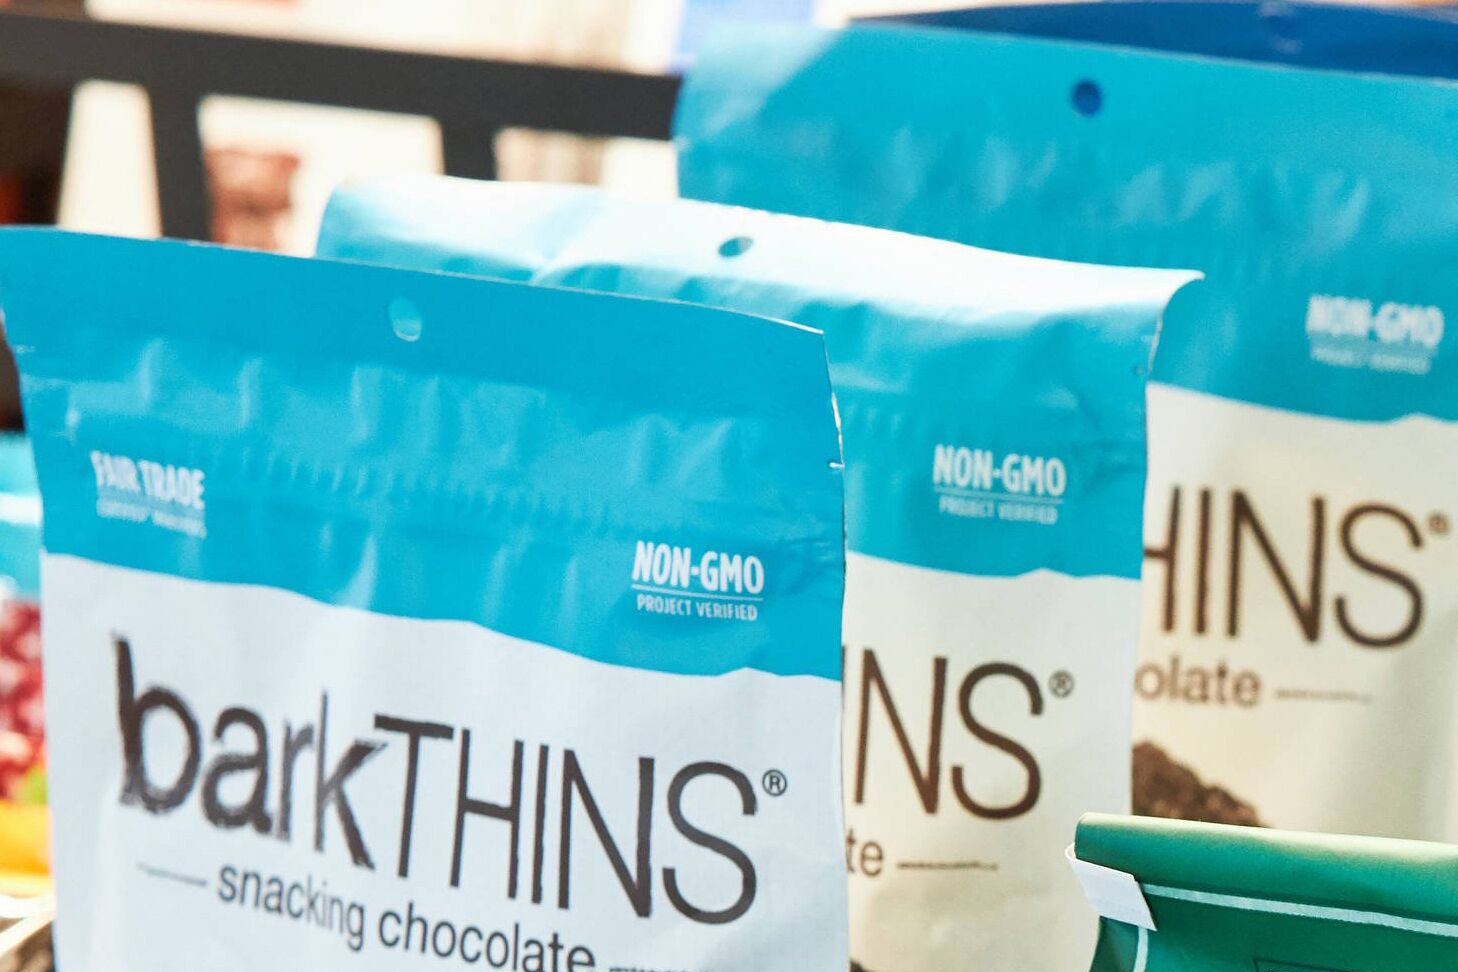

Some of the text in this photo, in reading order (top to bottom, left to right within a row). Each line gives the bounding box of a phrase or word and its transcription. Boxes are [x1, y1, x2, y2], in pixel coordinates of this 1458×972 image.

[933, 443, 1067, 497] NON-GMO
[631, 540, 765, 594] NON-GMO
[636, 594, 758, 621] PROJECT VERIFIED
[218, 862, 366, 952] snacking
